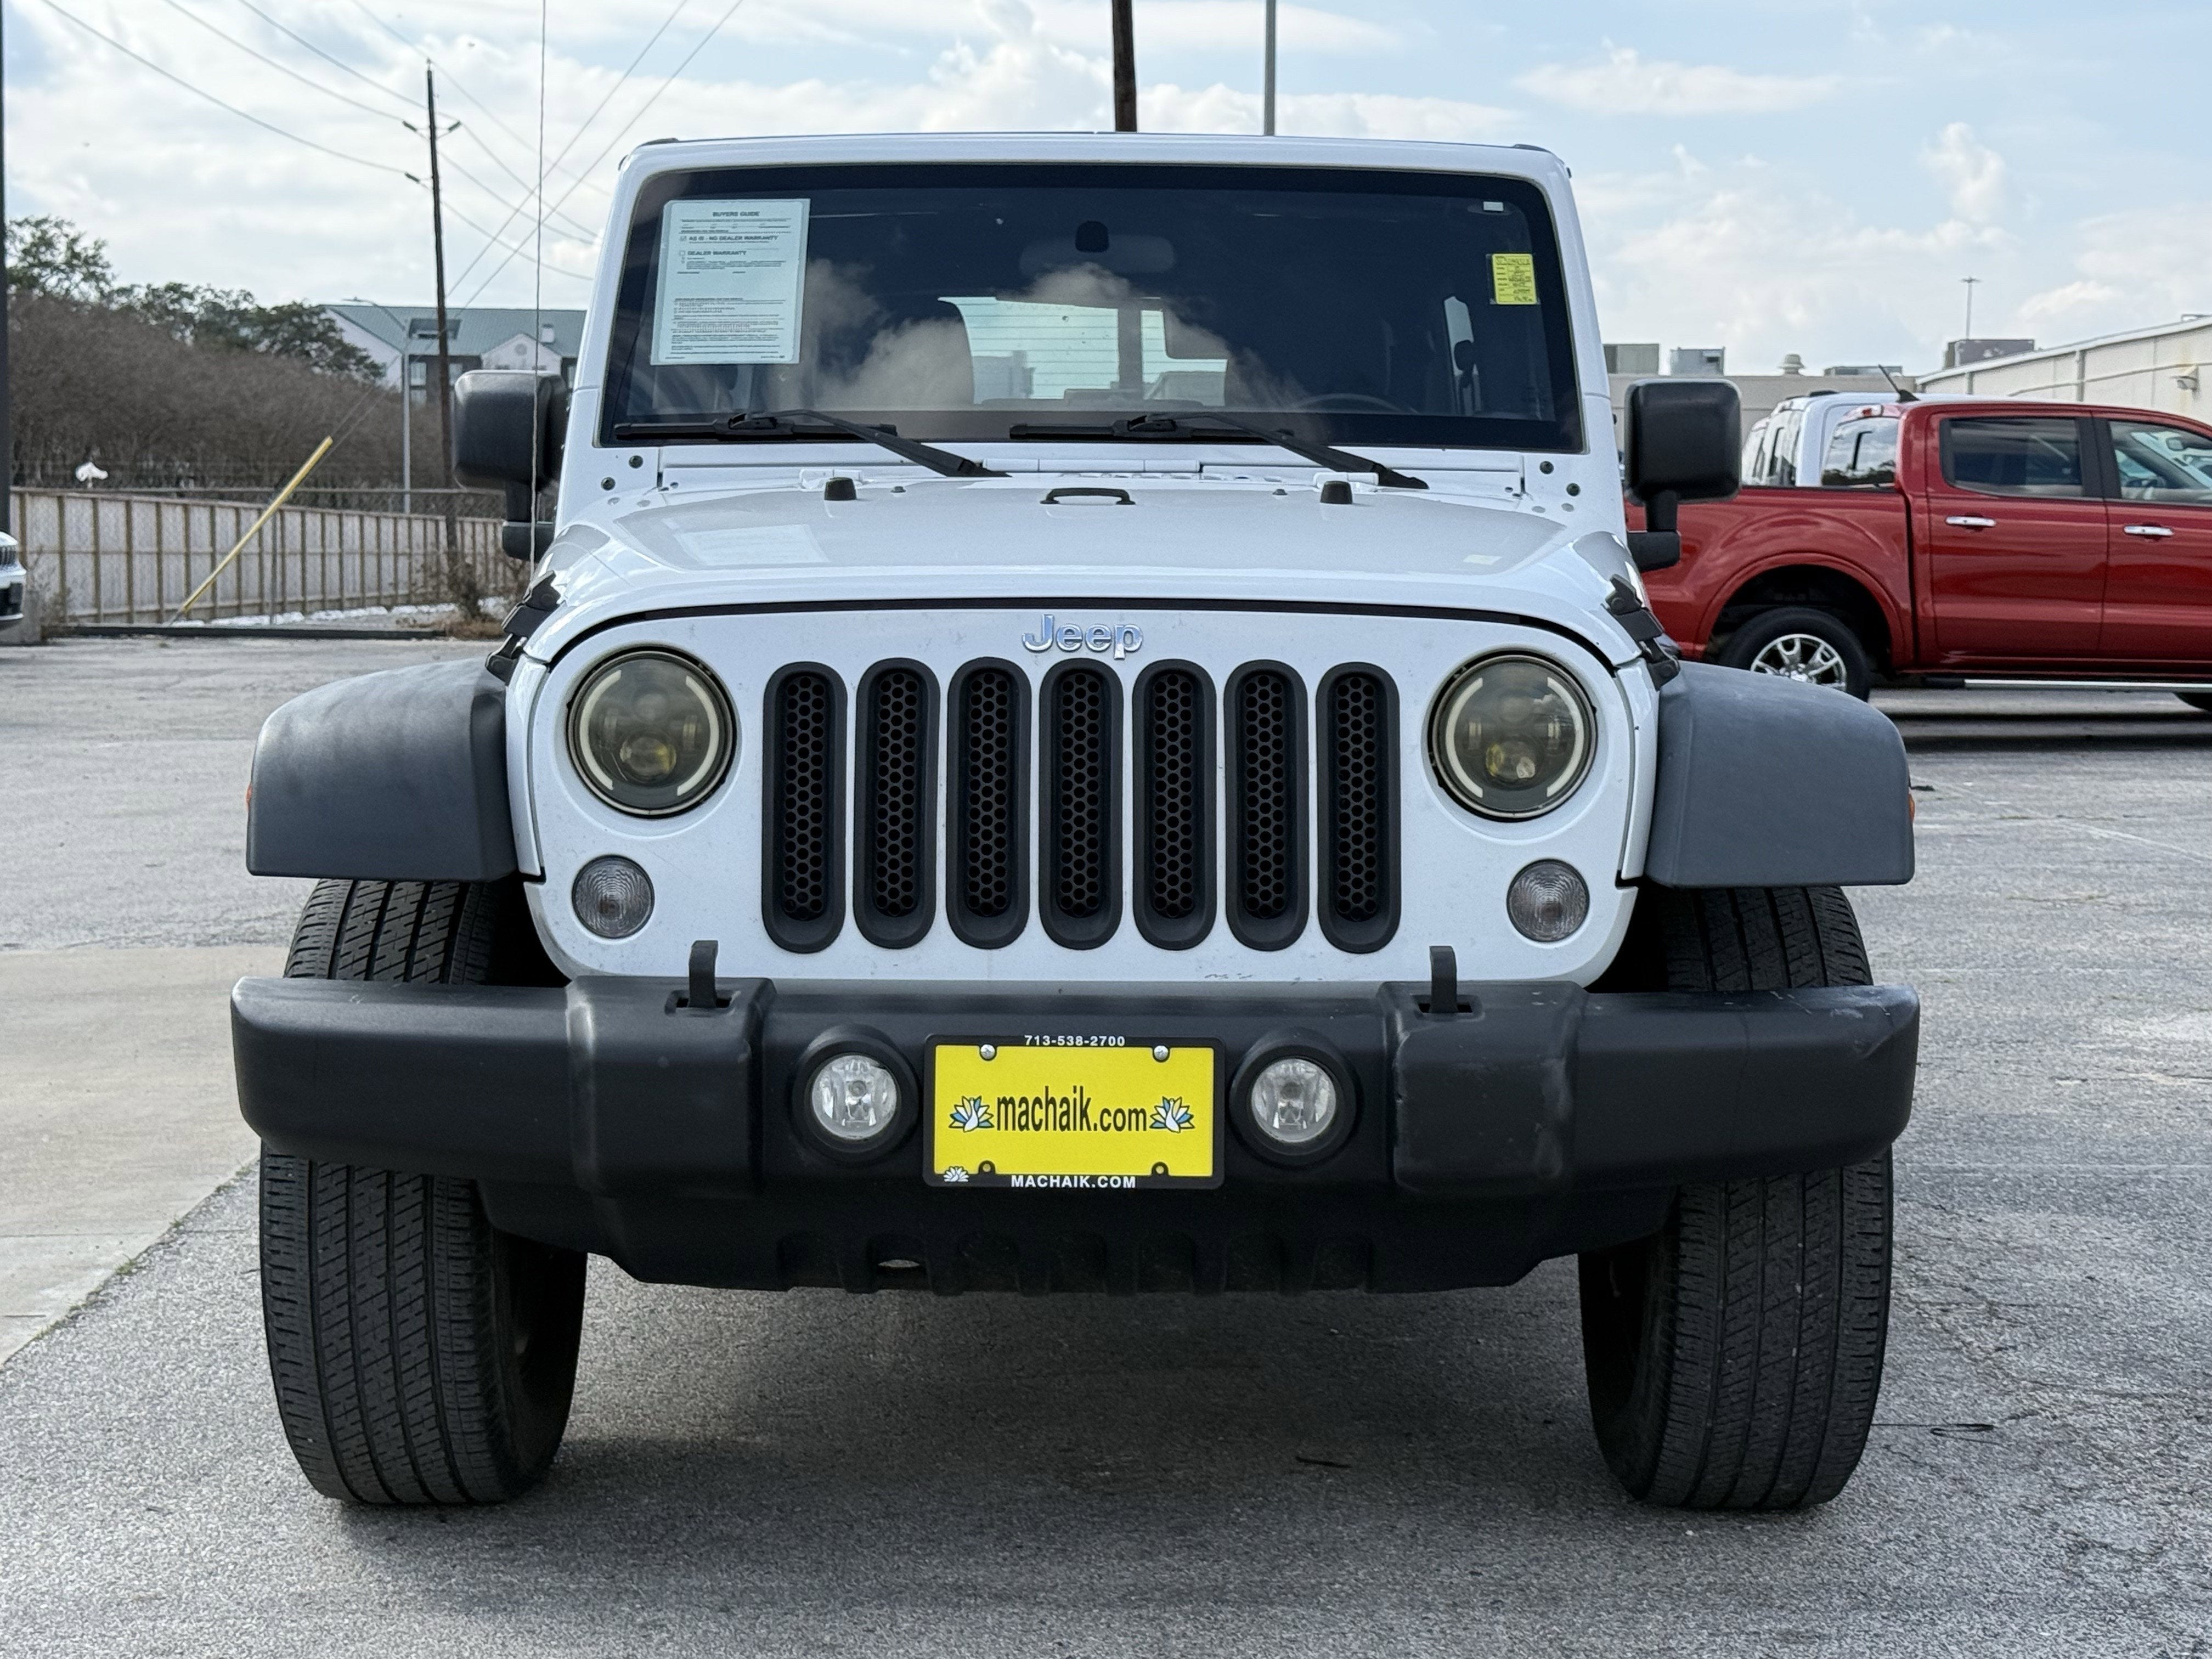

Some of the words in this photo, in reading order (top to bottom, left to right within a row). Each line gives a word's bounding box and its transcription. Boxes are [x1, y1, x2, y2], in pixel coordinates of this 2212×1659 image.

[1021, 614, 1143, 660] Jeep
[1024, 1035, 1125, 1046] 713-538-2700
[996, 1085, 1147, 1132] machaik.com
[1011, 1175, 1136, 1188] MACHAIK.COM
